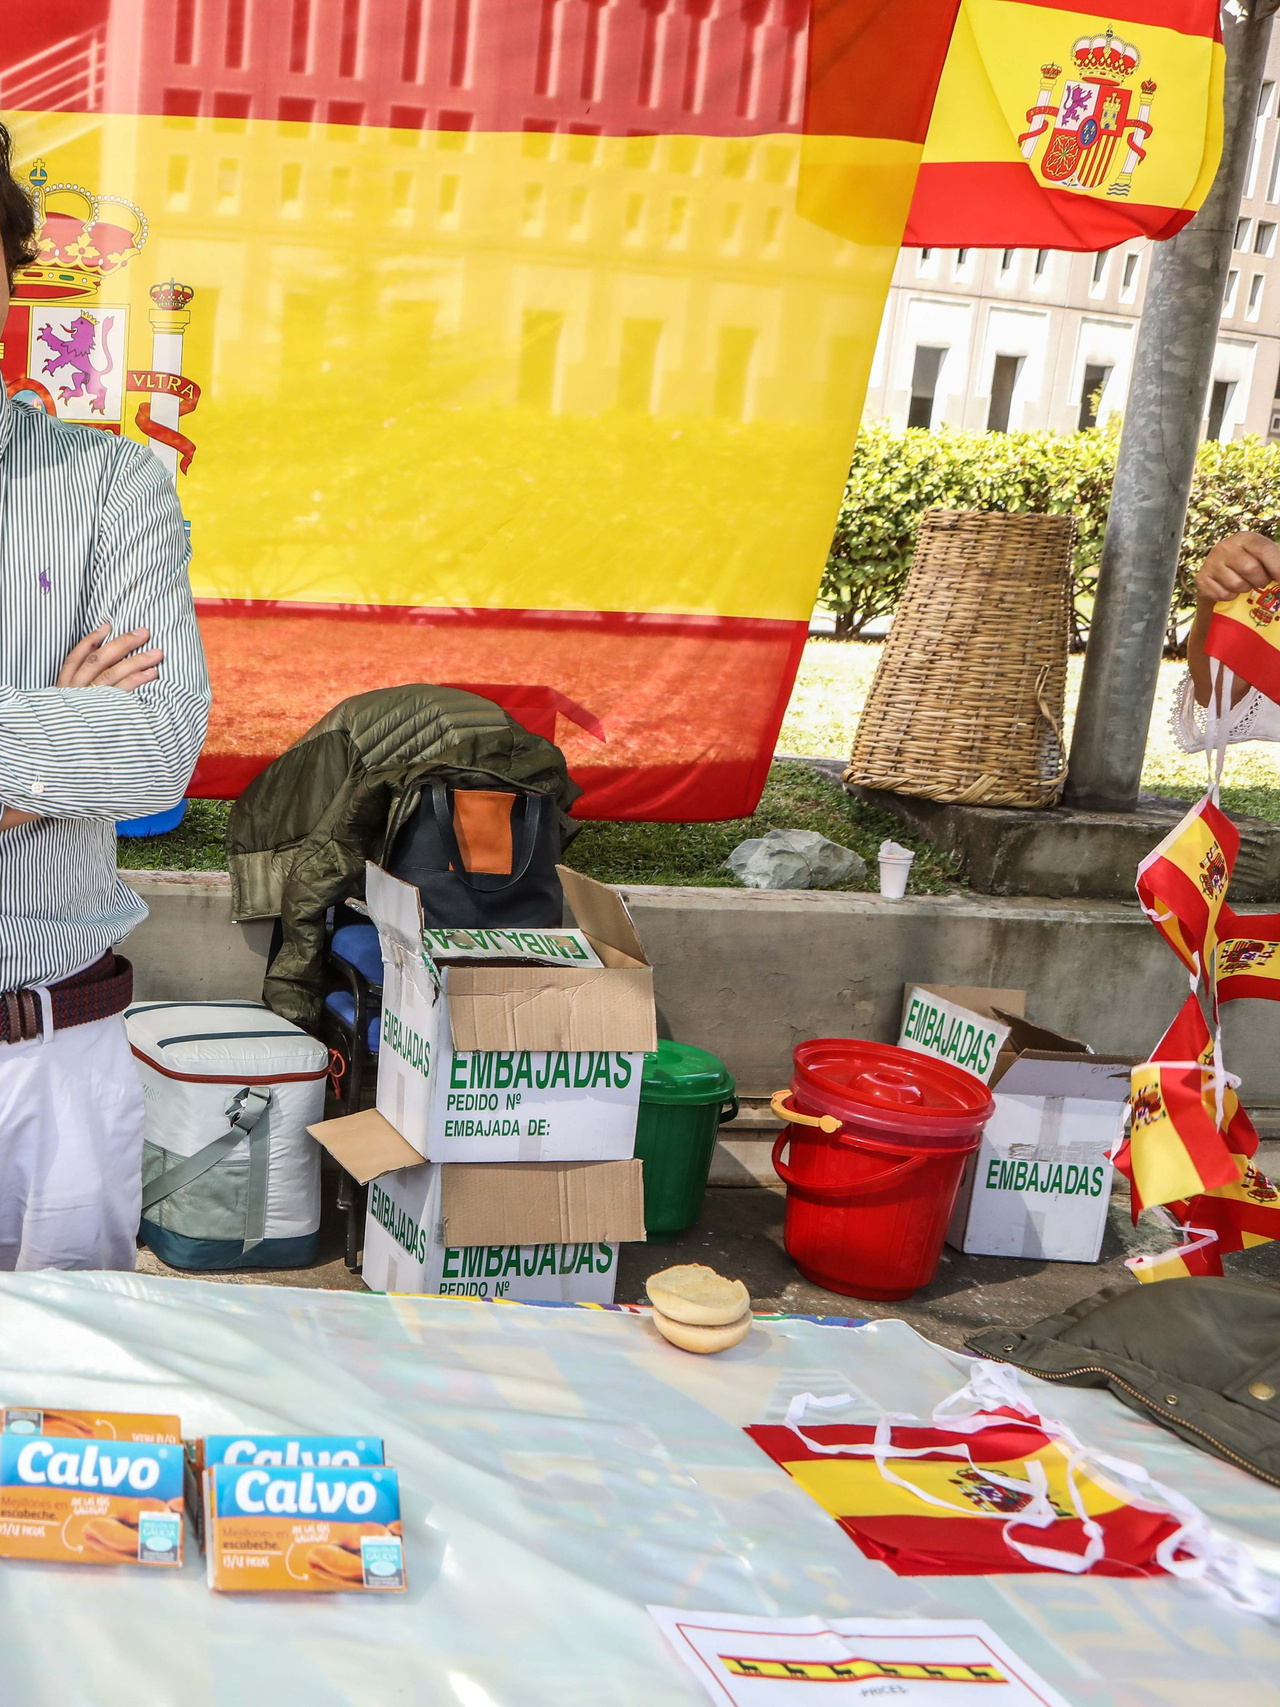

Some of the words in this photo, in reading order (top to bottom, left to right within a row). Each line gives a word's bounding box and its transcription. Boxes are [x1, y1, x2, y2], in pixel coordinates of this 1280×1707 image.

[131, 372, 195, 400] VLTRA
[383, 1008, 431, 1079] EMBAJADAS
[905, 998, 996, 1075] EMBAJADAS
[449, 1051, 633, 1090] EMBAJADAS
[446, 1094, 499, 1112] PEDIDO
[506, 1093, 522, 1112] Nº
[444, 1119, 520, 1138] EMBAJADA
[527, 1119, 551, 1137] DE:
[985, 1159, 1104, 1197] EMBAJADAS
[370, 1183, 427, 1266] EMBAJADAS
[442, 1241, 614, 1280] EMBAJADAS
[439, 1282, 488, 1297] PEDIDO
[17, 1440, 160, 1491] Calvo
[235, 1470, 377, 1515] Calvo
[1, 1507, 56, 1519] escabeche
[860, 1684, 908, 1697] PRICES
